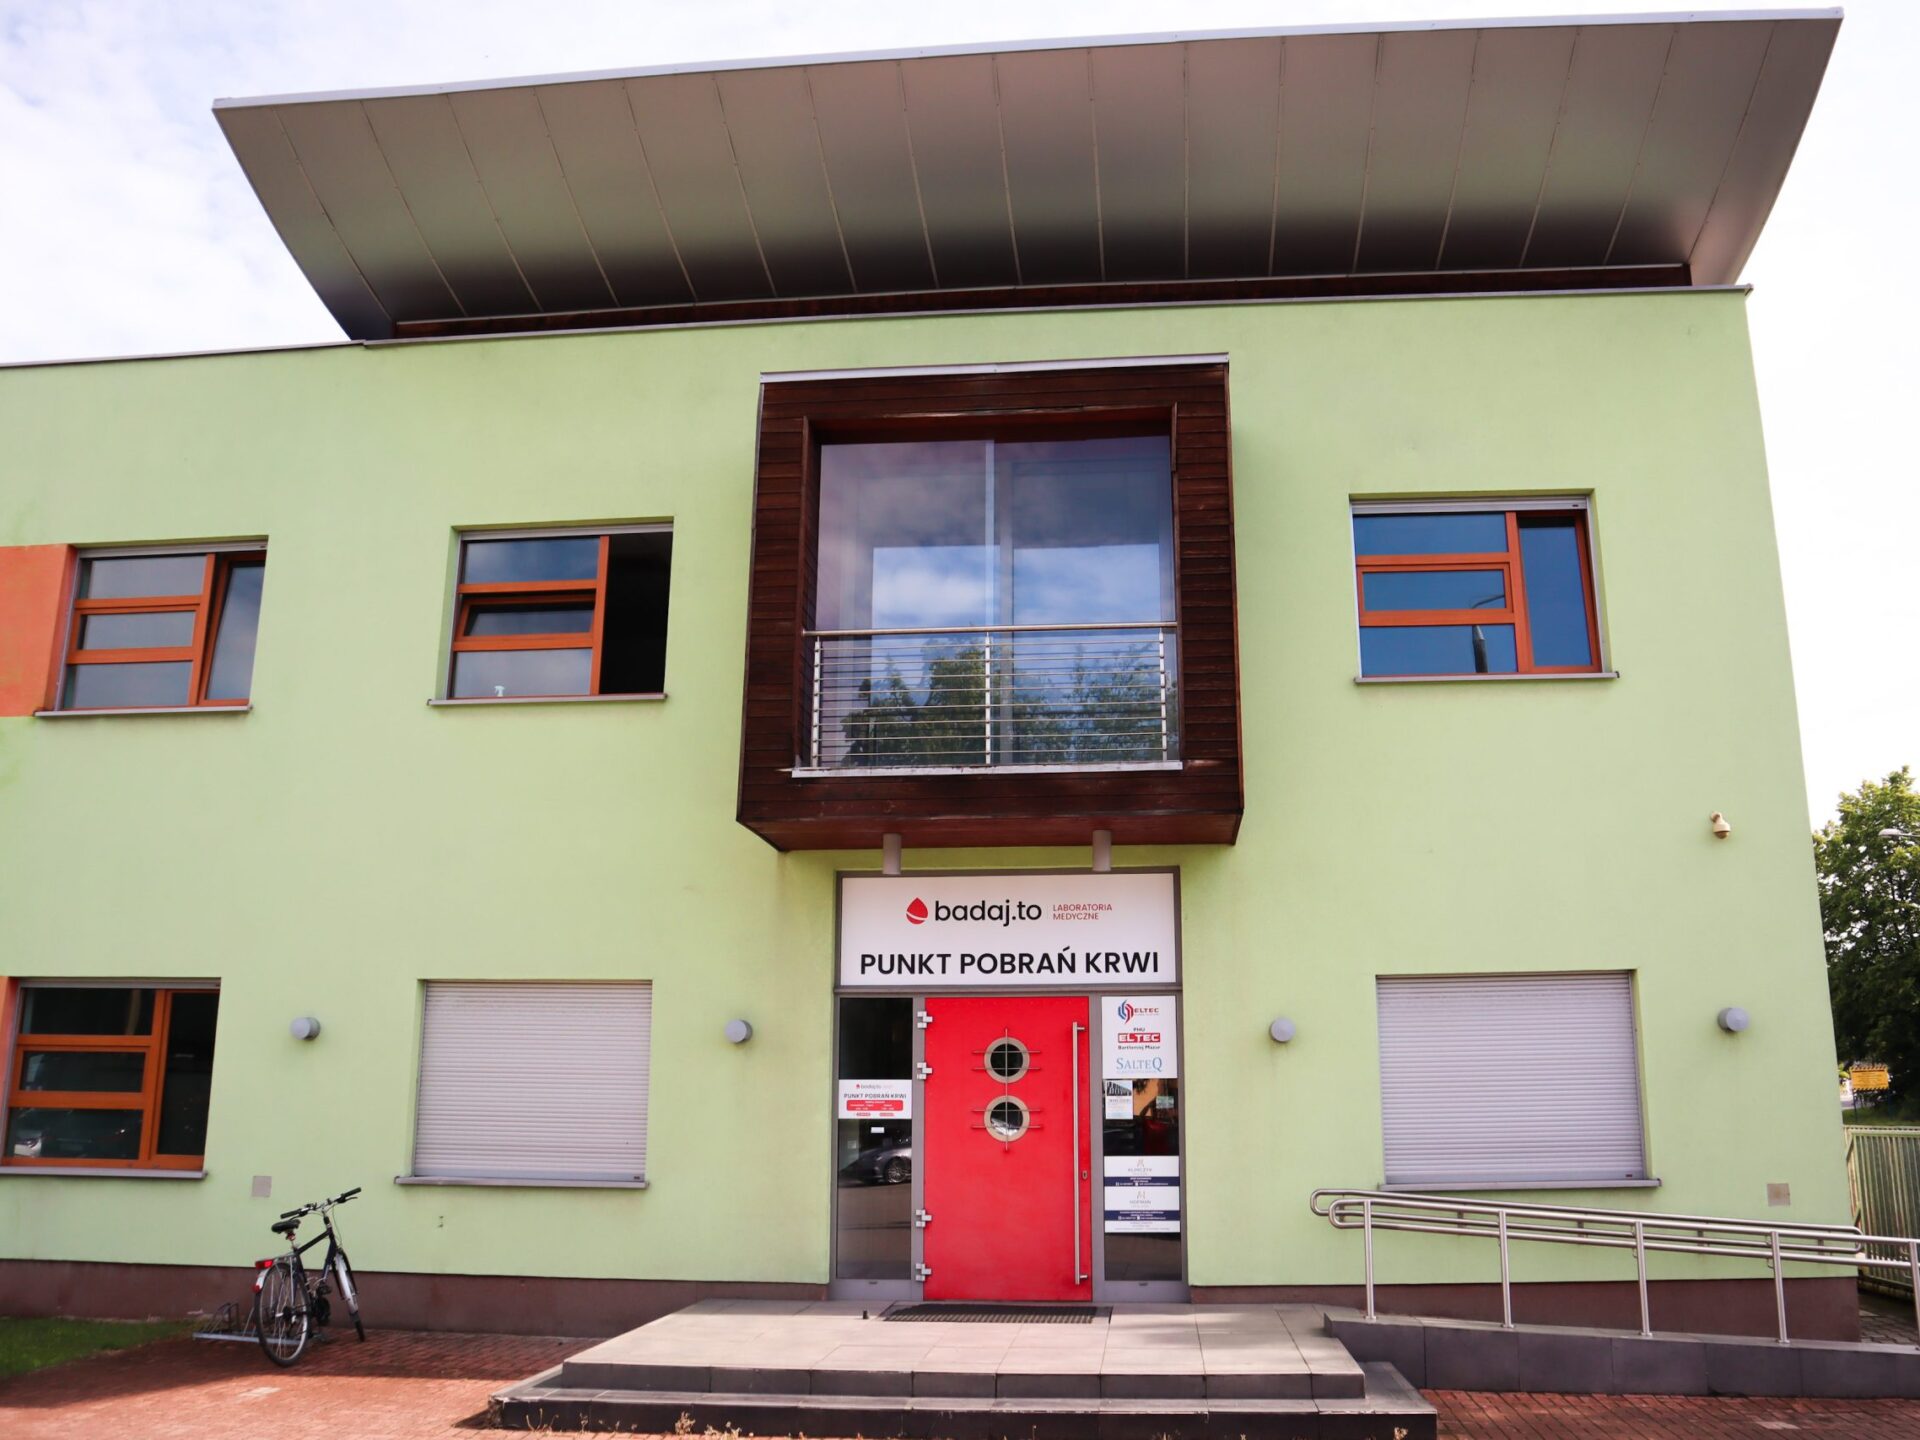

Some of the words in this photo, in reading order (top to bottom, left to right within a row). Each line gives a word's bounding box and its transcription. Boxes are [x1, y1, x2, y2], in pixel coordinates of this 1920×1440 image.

[934, 900, 1042, 927] badaj.to
[1052, 903, 1113, 912] LABORATORIA
[1052, 912, 1099, 921] MEDYCZNE
[860, 953, 951, 975] PUNKT
[959, 945, 1076, 974] POBRAŃ
[1085, 951, 1159, 973] KRWI
